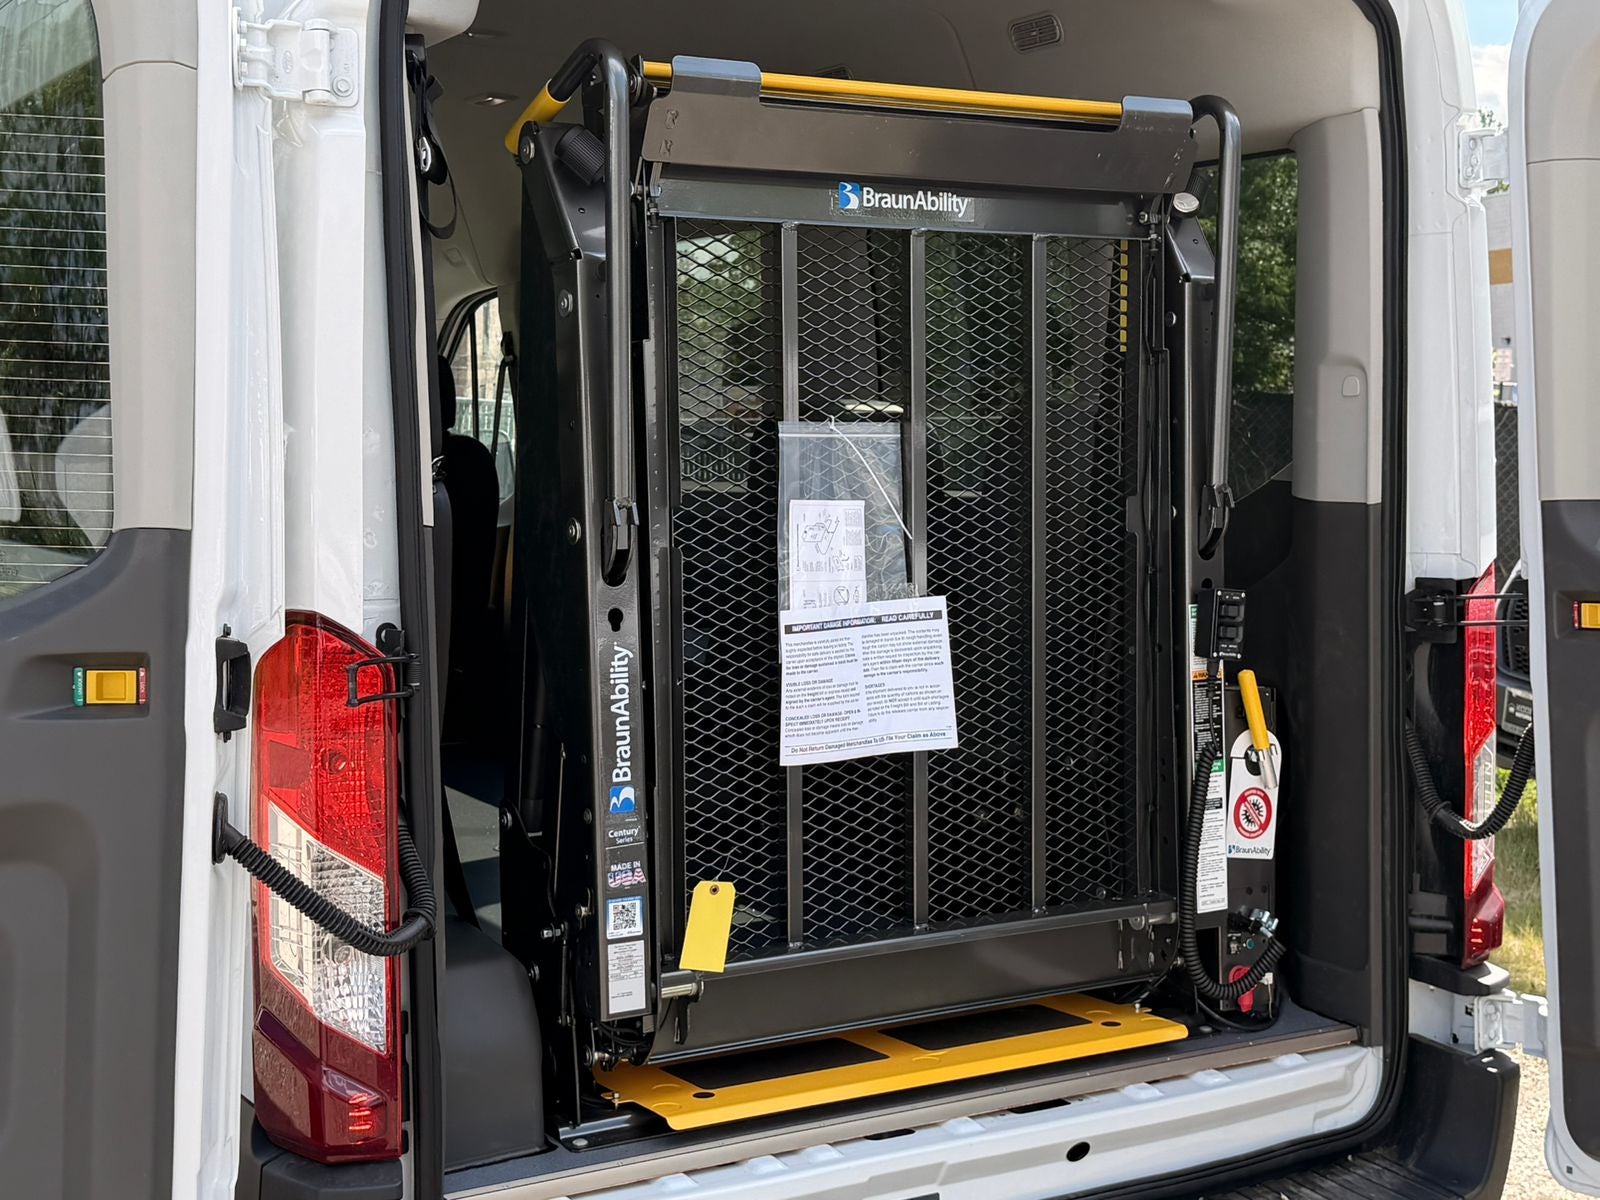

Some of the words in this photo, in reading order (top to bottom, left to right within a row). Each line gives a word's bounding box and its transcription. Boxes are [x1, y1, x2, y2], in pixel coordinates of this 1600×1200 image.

[863, 186, 969, 218] BraunAbility
[792, 623, 823, 632] IMPORTANT
[881, 614, 898, 622] READ
[898, 611, 934, 621] CAREFULLY
[610, 644, 634, 783] BraunAbility
[791, 746, 799, 754] Do
[799, 745, 808, 753] Not
[808, 743, 825, 752] Return
[824, 741, 846, 751] Damaged
[907, 732, 922, 740] Claim
[929, 730, 946, 738] Above
[608, 827, 640, 838] Century
[616, 836, 633, 845] Series
[1235, 845, 1272, 857] BraunAbility
[611, 861, 632, 872] MADE
[633, 860, 641, 868] IN
[607, 868, 647, 889] USA
